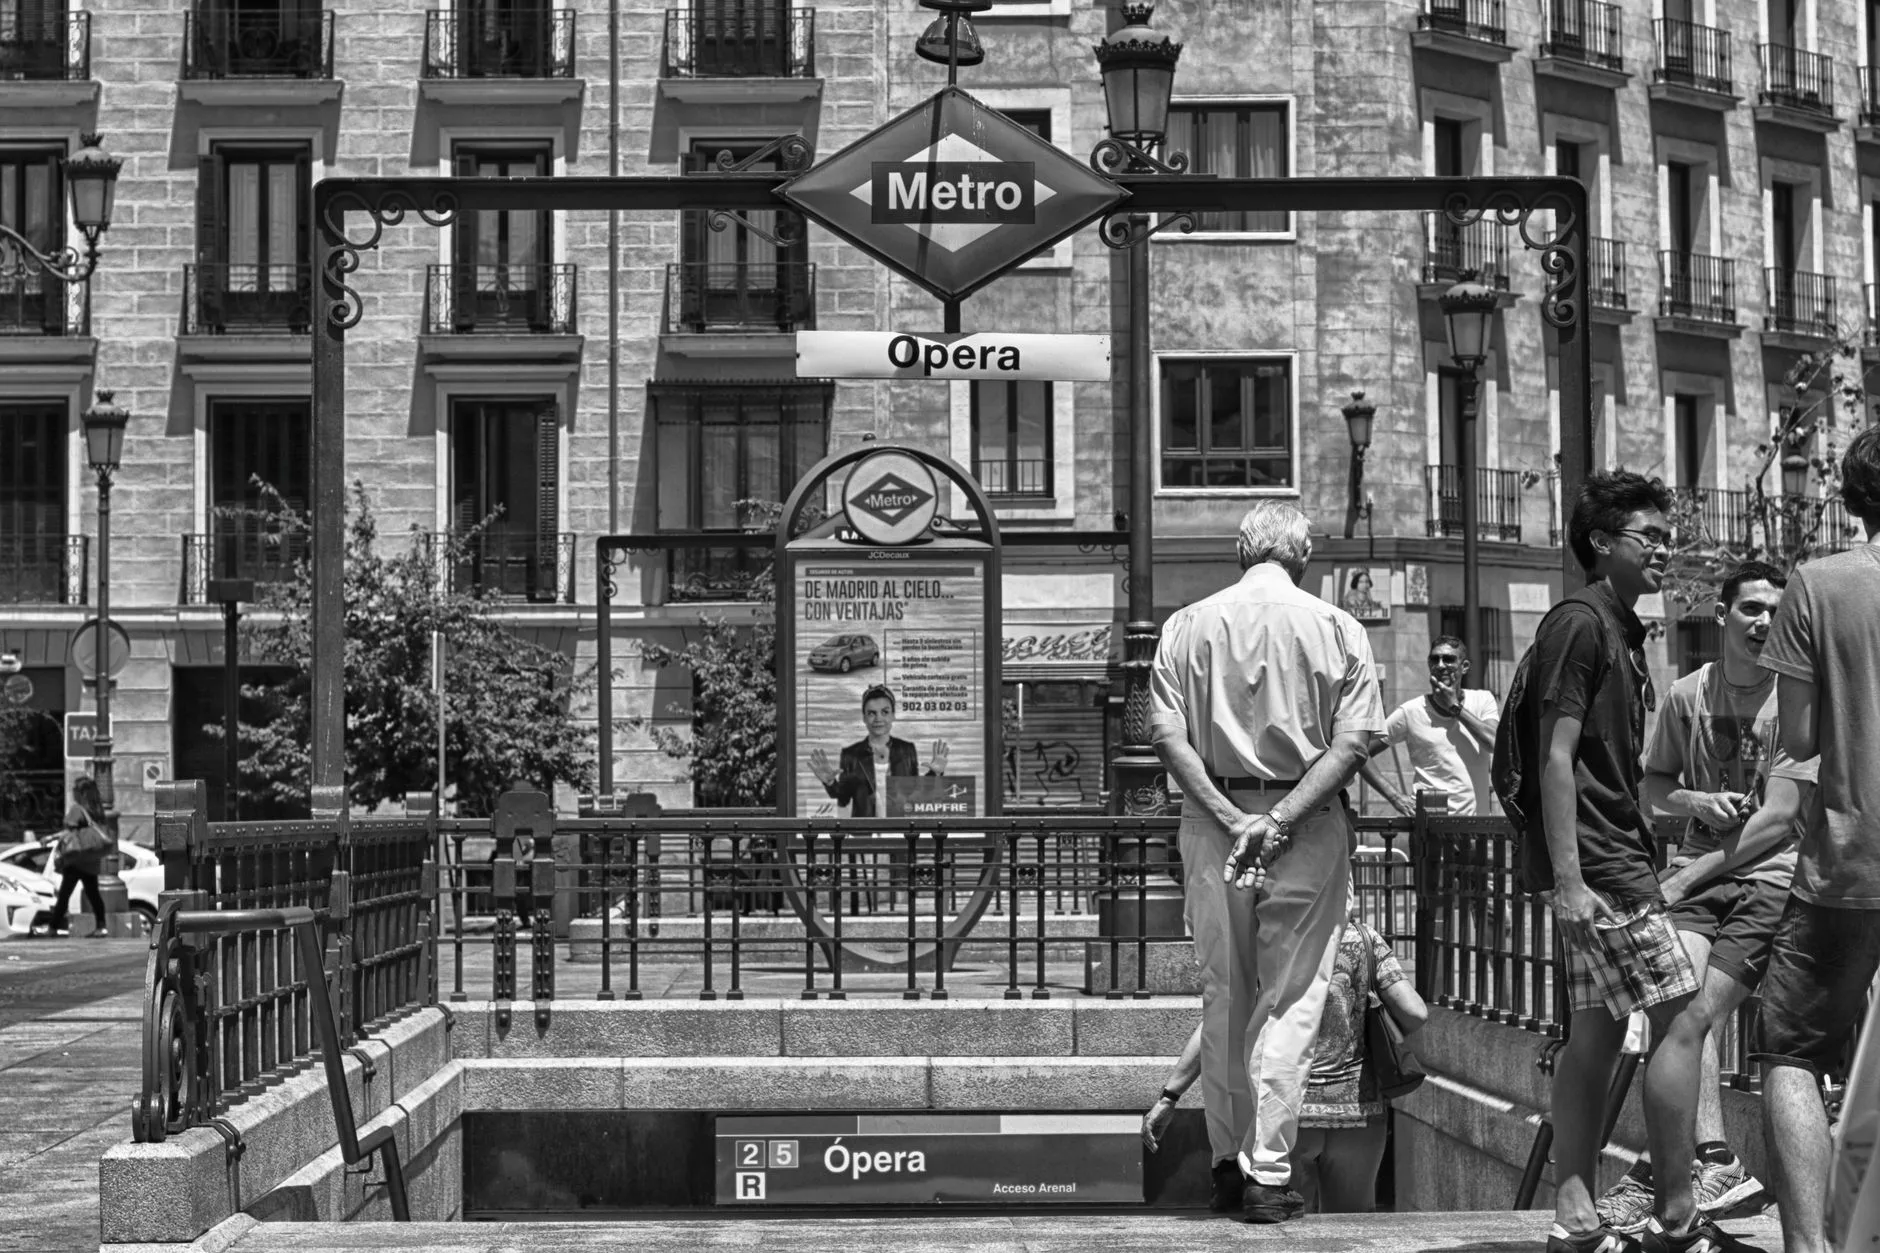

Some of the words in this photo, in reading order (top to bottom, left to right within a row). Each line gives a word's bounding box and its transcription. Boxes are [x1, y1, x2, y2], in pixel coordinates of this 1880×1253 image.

[888, 171, 1023, 211] Metro
[887, 335, 1021, 376] Opera
[870, 494, 912, 508] Metro
[868, 551, 909, 560] JCDecaux
[805, 580, 821, 598] DE
[826, 580, 878, 598] MADRID
[883, 580, 899, 598] AL
[904, 580, 954, 599] CIELO...
[805, 601, 831, 620] CON
[902, 701, 922, 711] 902
[924, 701, 937, 711] 03
[939, 701, 952, 711] 02
[954, 701, 967, 711] 03
[914, 803, 968, 812] MAPFRE
[742, 1143, 759, 1165] 2
[776, 1143, 792, 1165] 5
[824, 1137, 926, 1179] Ópera
[742, 1174, 760, 1198] R
[993, 1183, 1035, 1194] Acceso
[1038, 1182, 1076, 1194] Arenal
